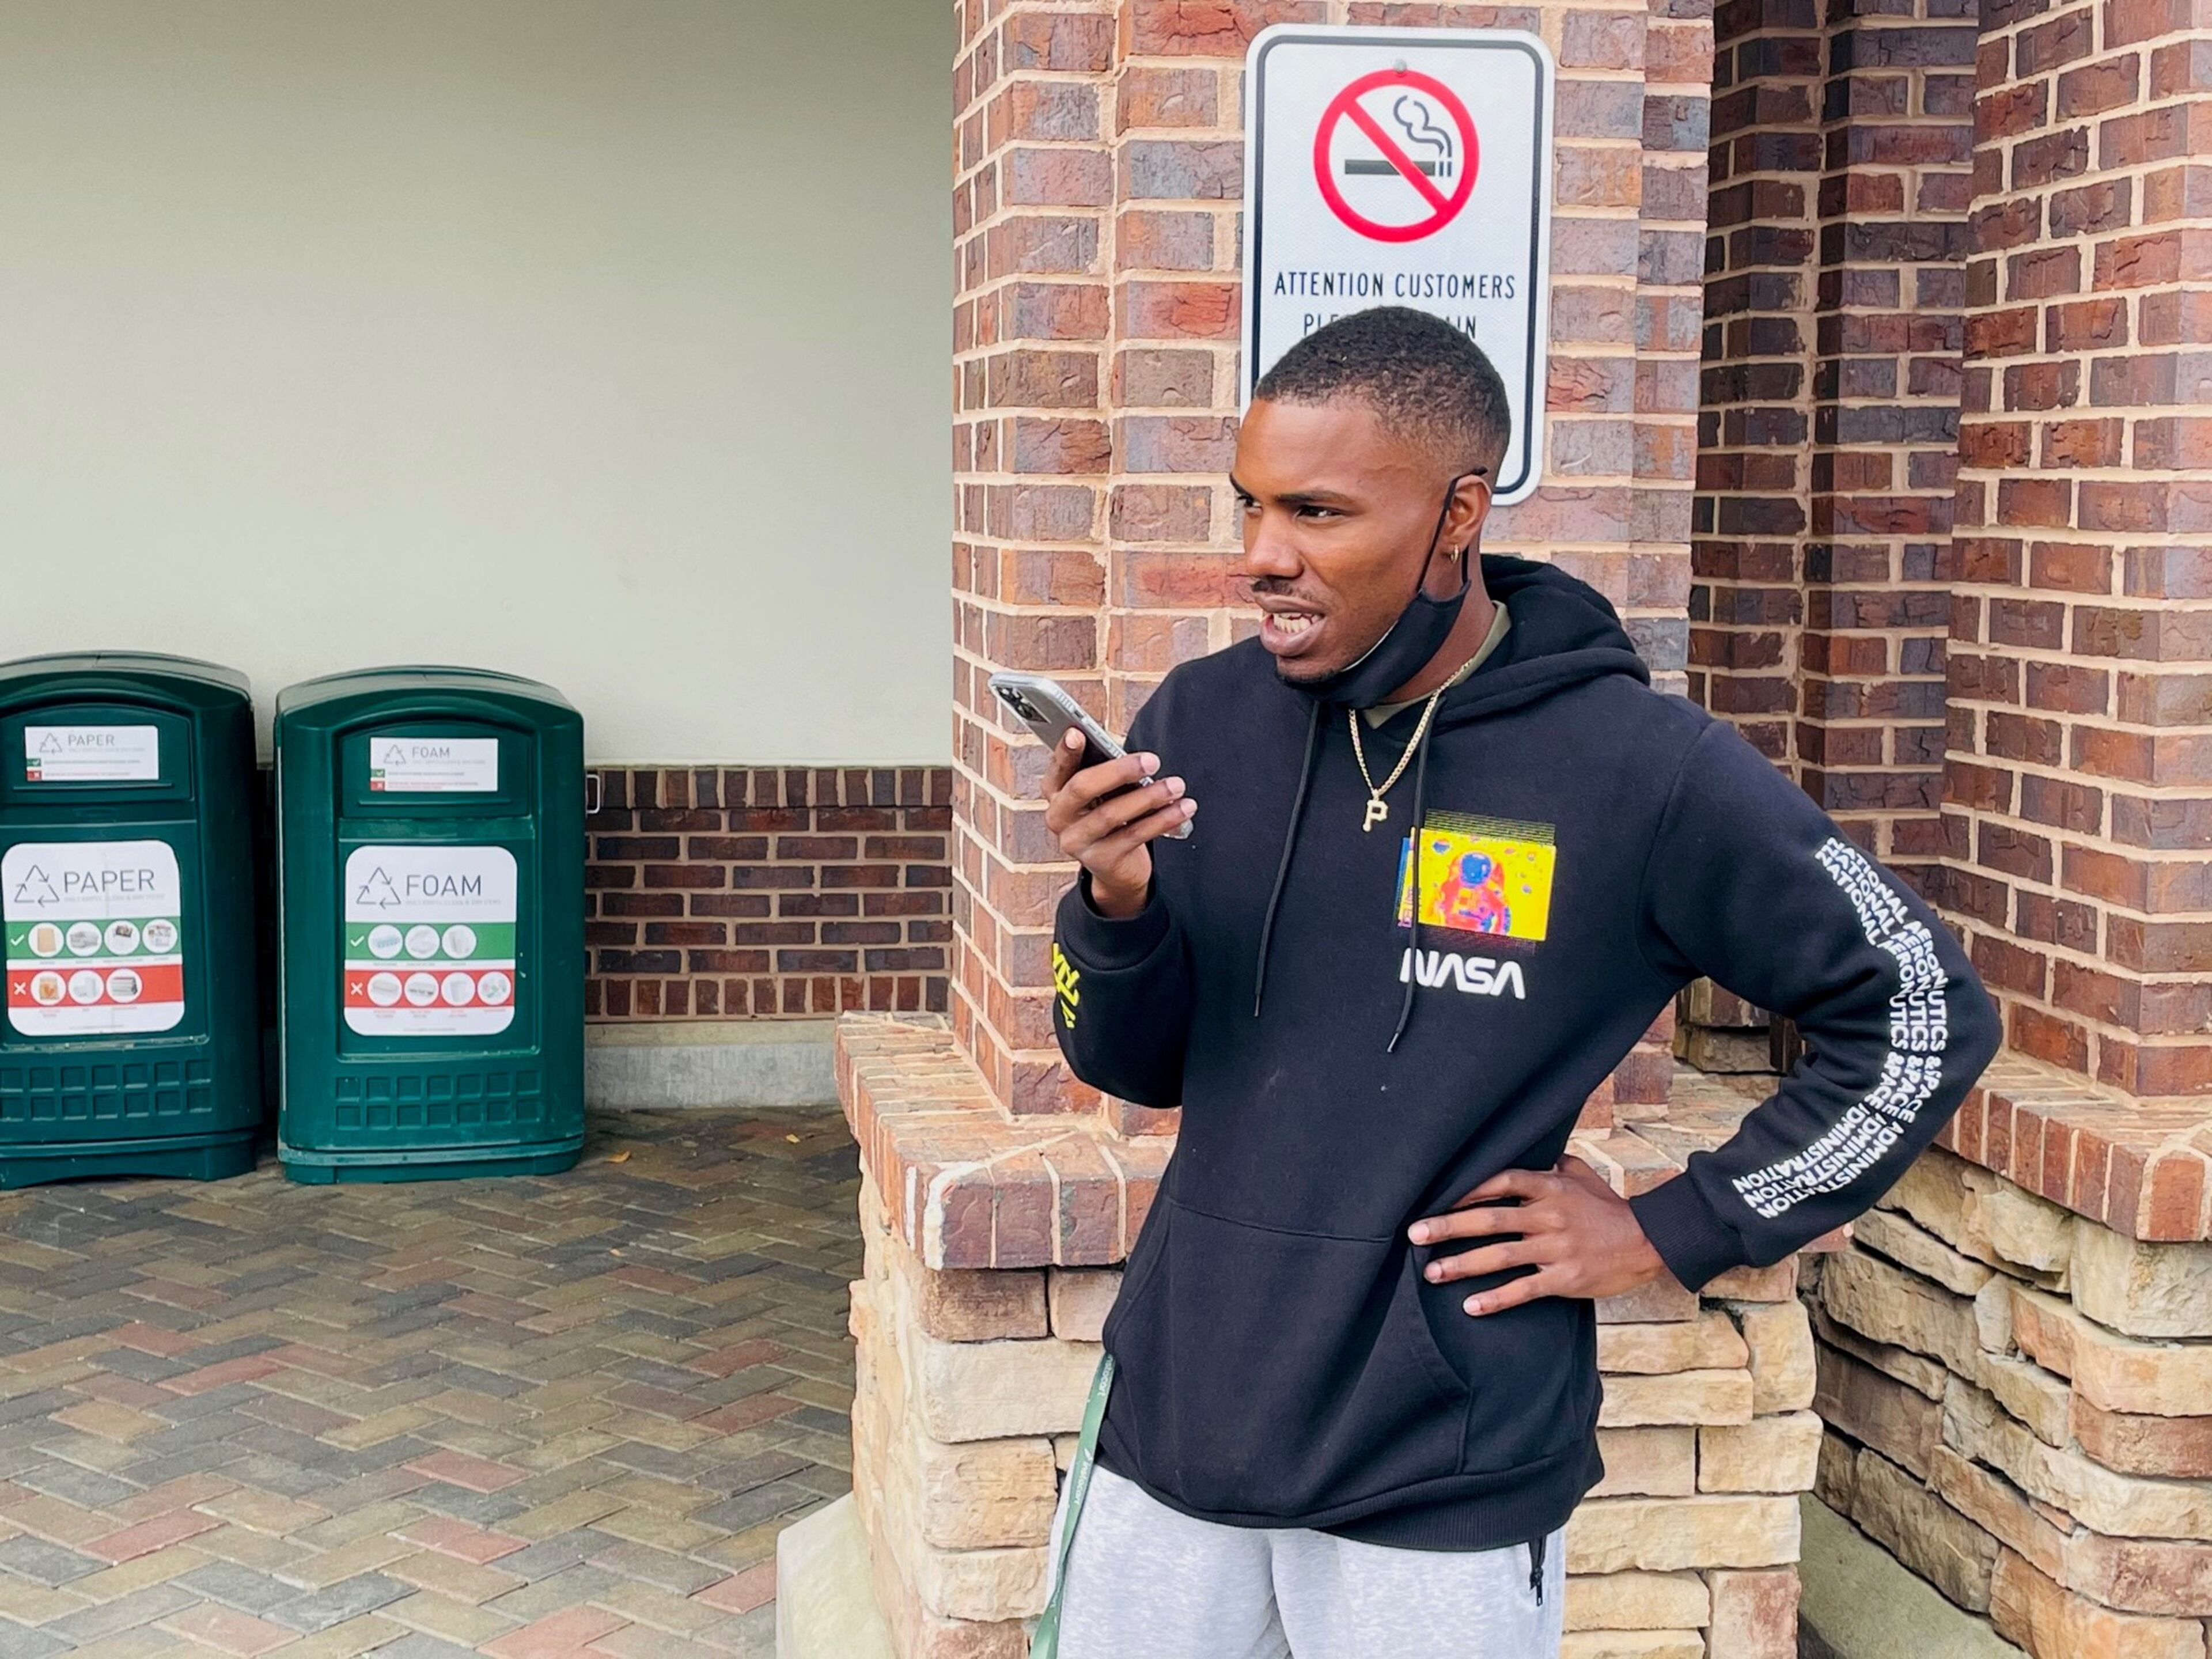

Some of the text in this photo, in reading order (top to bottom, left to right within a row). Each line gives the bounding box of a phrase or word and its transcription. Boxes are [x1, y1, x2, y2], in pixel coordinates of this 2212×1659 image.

[1274, 272, 1516, 298] ATTENTION CUSTOMERS
[68, 733, 115, 747] PAPER
[412, 747, 450, 759] FOAM
[1362, 800, 1388, 832] P
[64, 869, 155, 893] PAPER
[407, 874, 482, 896] FOAM
[1815, 851, 1881, 946] NATIONAL
[1821, 844, 1896, 935] NATIONAL
[1827, 837, 1908, 924] NATIONAL
[1903, 921, 1948, 1052] AERONUTICS
[1400, 947, 1526, 1000] NASA
[1877, 940, 1915, 1050] AERONUTICS
[1890, 931, 1932, 1052] AERONUTICS
[1864, 1063, 1902, 1109] PACE
[1881, 1068, 1922, 1117] PACE
